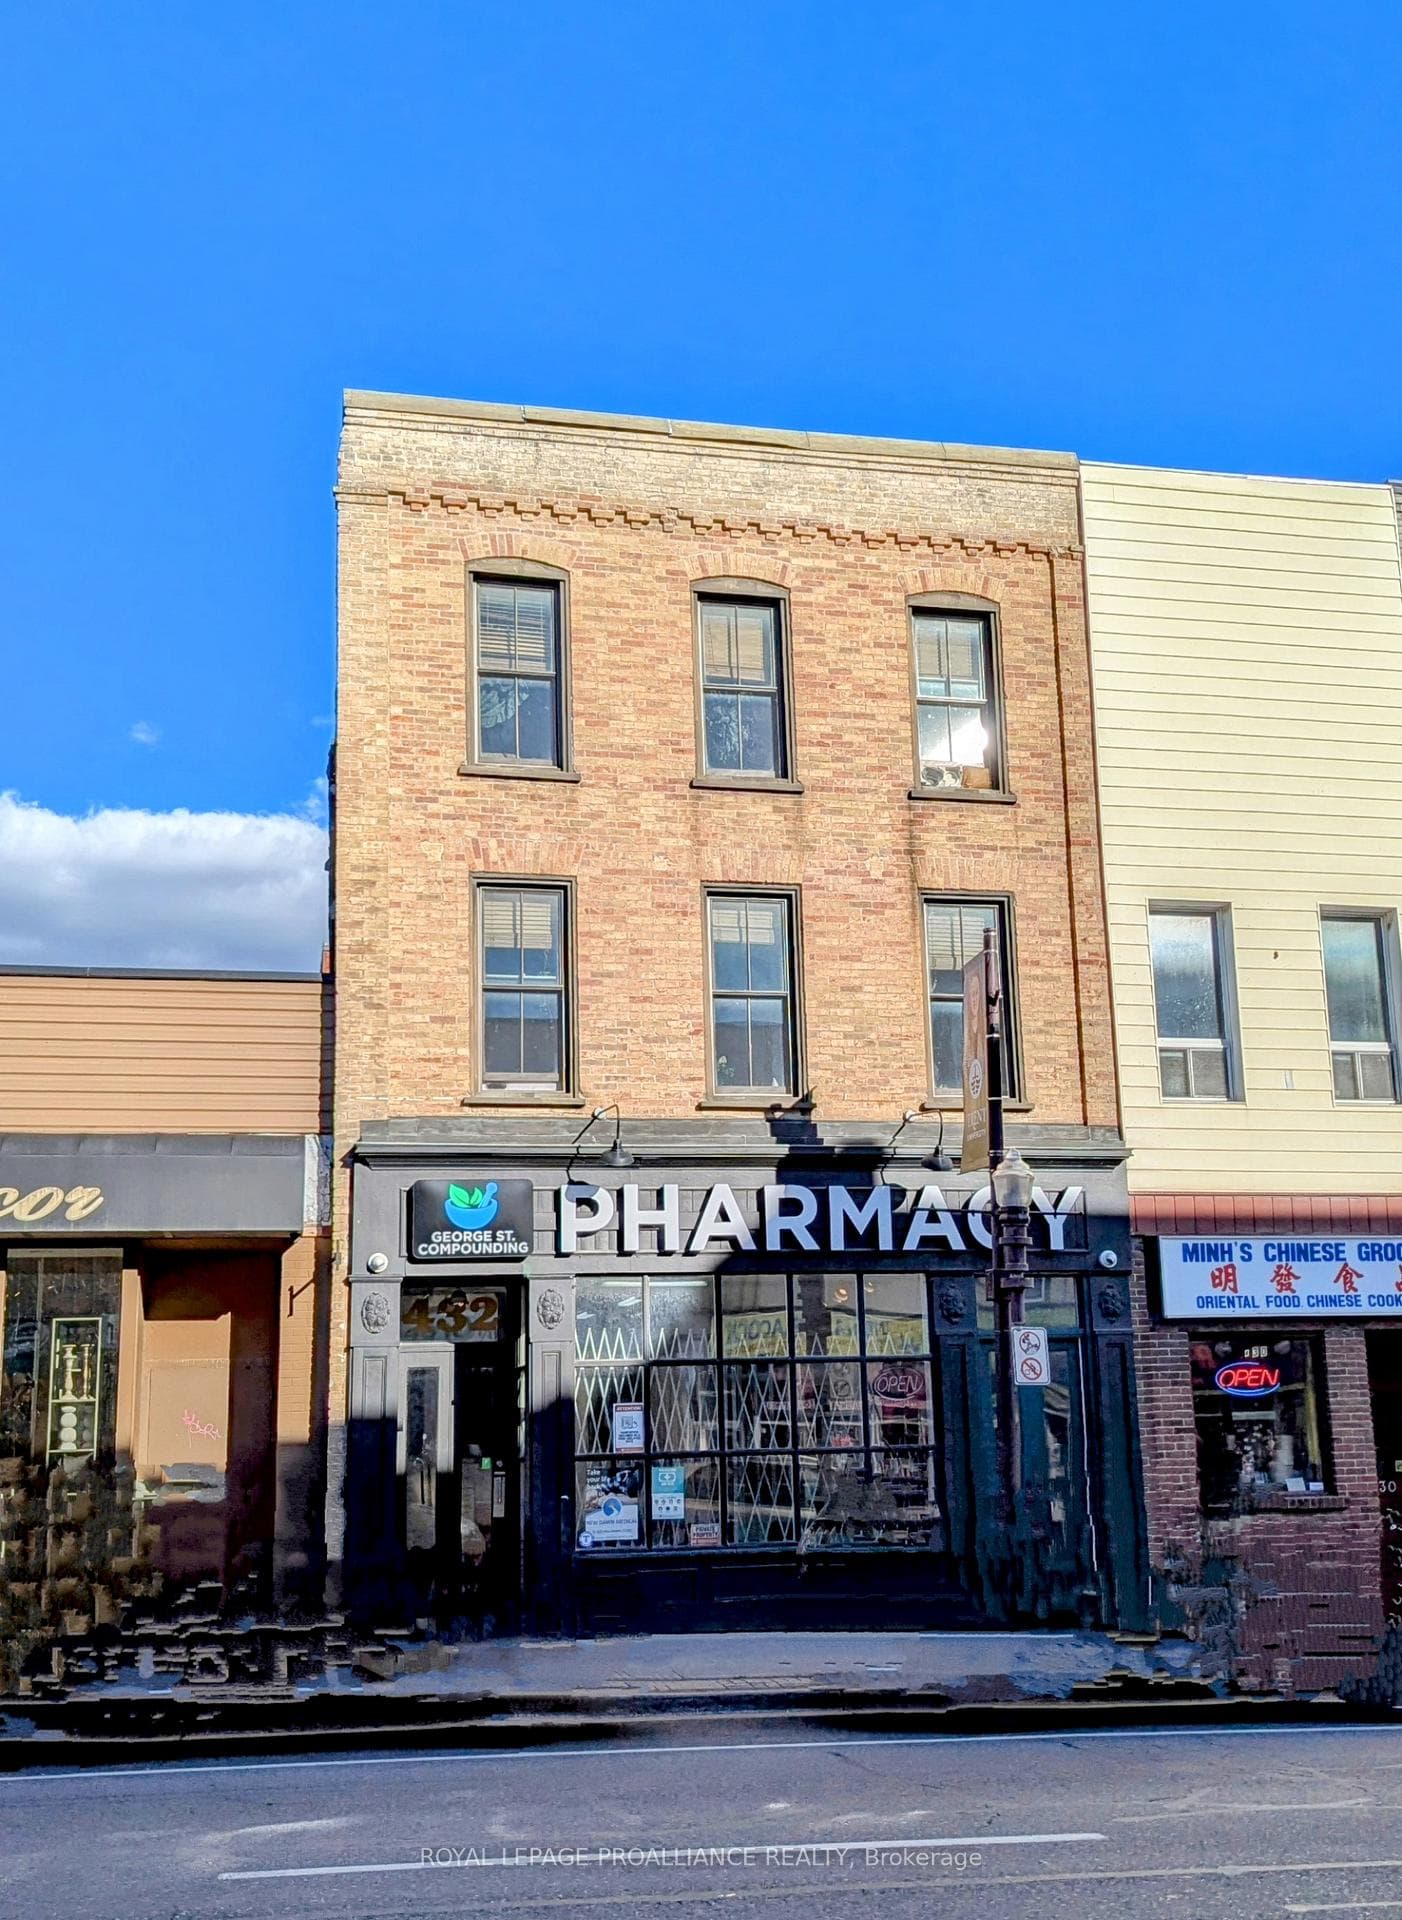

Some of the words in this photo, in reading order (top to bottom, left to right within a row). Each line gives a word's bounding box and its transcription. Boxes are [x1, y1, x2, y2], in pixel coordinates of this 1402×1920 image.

[431, 1231, 493, 1243] GEORGE
[495, 1230, 516, 1241] ST.
[417, 1242, 529, 1255] COMPOUNDING
[1182, 1242, 1253, 1263] MINH'S
[1263, 1242, 1347, 1263] CHINESE
[1210, 1263, 1402, 1294] 明發食
[1196, 1295, 1260, 1309] ORIENTAL
[1306, 1294, 1363, 1308] CHINESE
[400, 1297, 500, 1335] 432
[876, 1374, 918, 1393] OPEN
[1219, 1369, 1280, 1388] OPEN
[1378, 1481, 1397, 1493] 30
